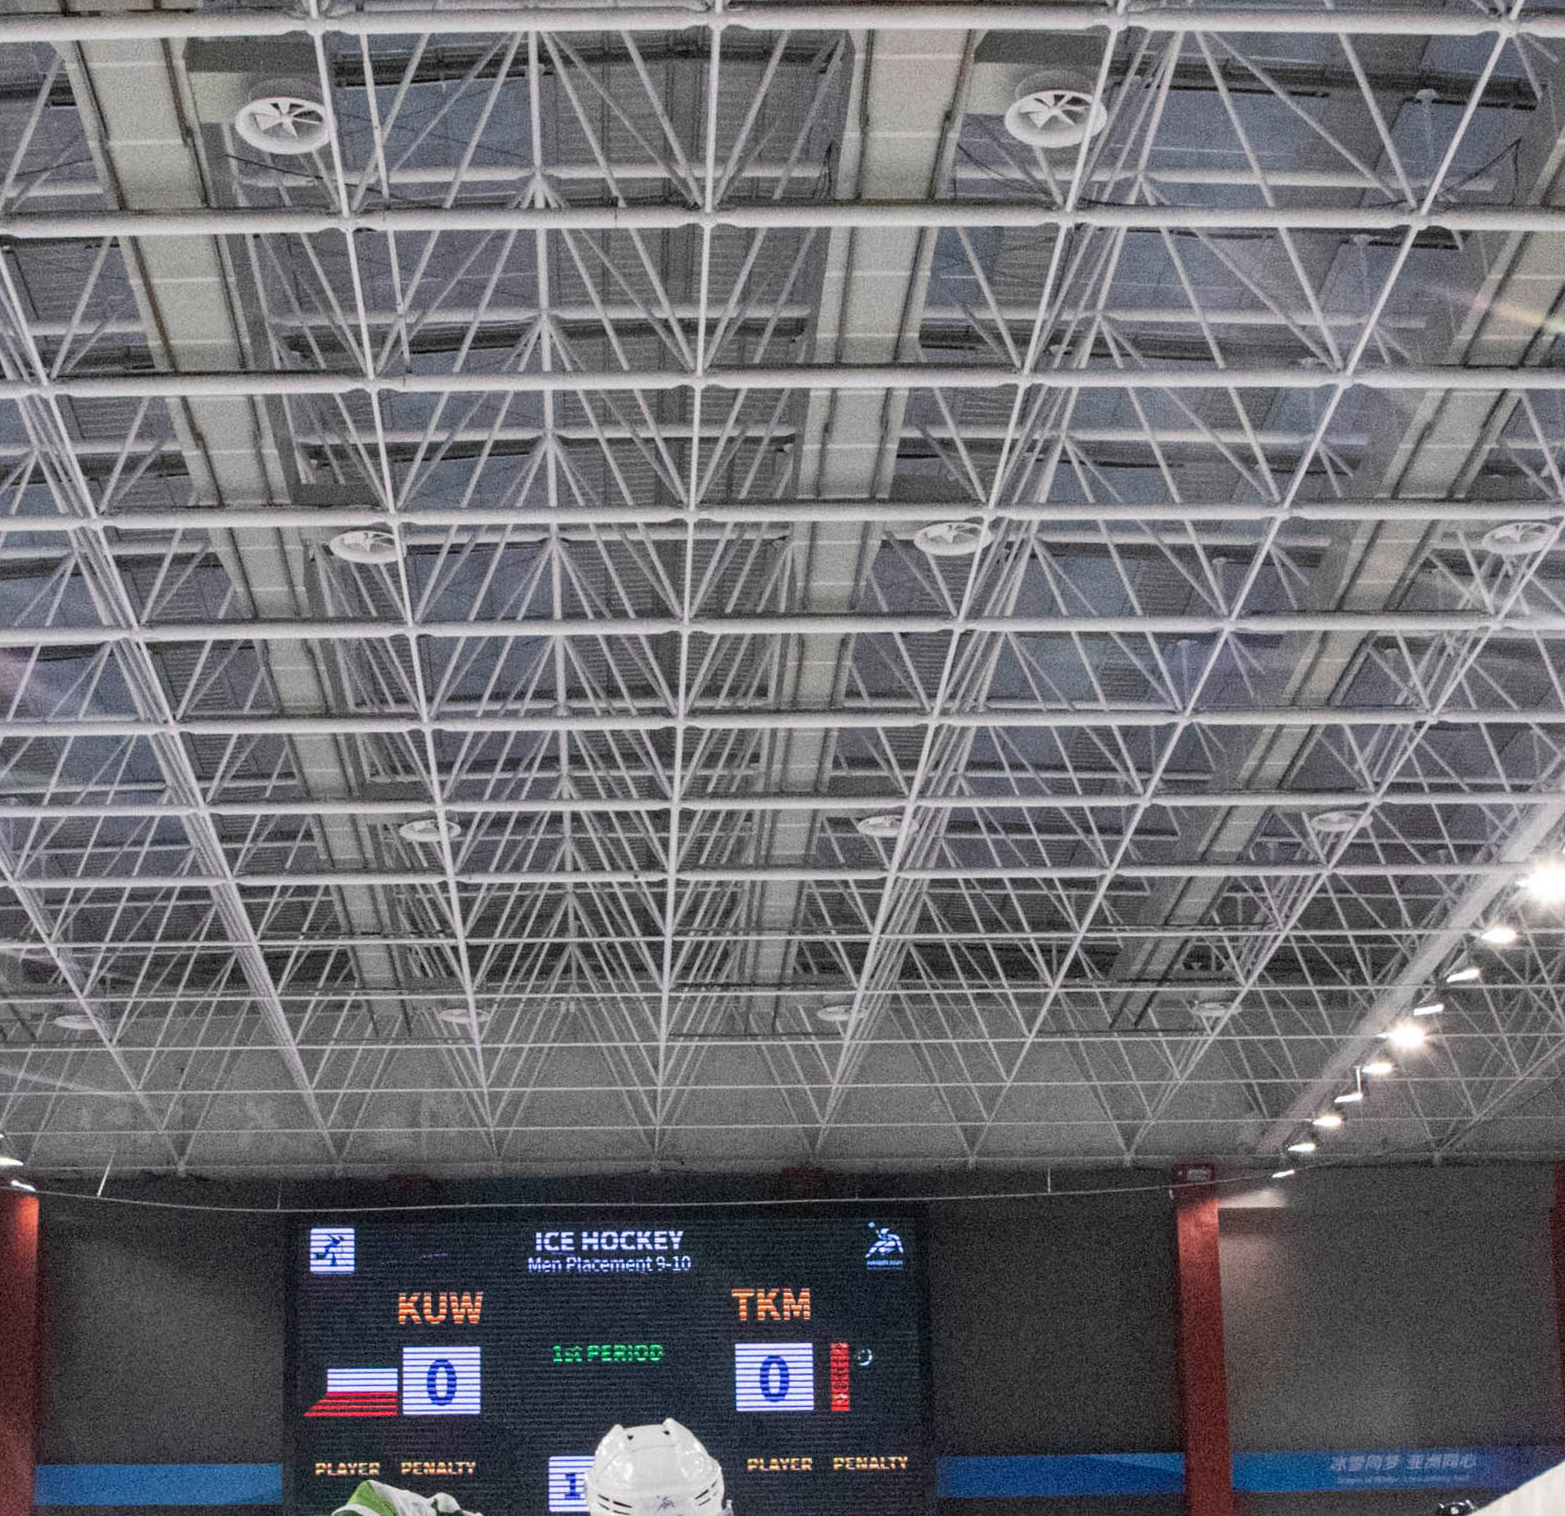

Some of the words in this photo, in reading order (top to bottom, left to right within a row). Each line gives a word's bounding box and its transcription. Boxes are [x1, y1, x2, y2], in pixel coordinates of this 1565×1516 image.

[535, 1231, 575, 1251] ICE
[581, 1230, 684, 1251] HOCKEY
[527, 1256, 562, 1273] Men
[566, 1255, 653, 1273] Placement
[656, 1255, 692, 1272] 9-10
[397, 1291, 484, 1325] KUW
[731, 1288, 812, 1322] TKM
[586, 1343, 664, 1362] PERIOD
[425, 1358, 457, 1406] 0
[758, 1354, 790, 1402] 0
[315, 1461, 381, 1476] PLAYER
[401, 1461, 477, 1476] PENALTY
[746, 1455, 814, 1472] PLAYER
[833, 1454, 909, 1471] PENALTY
